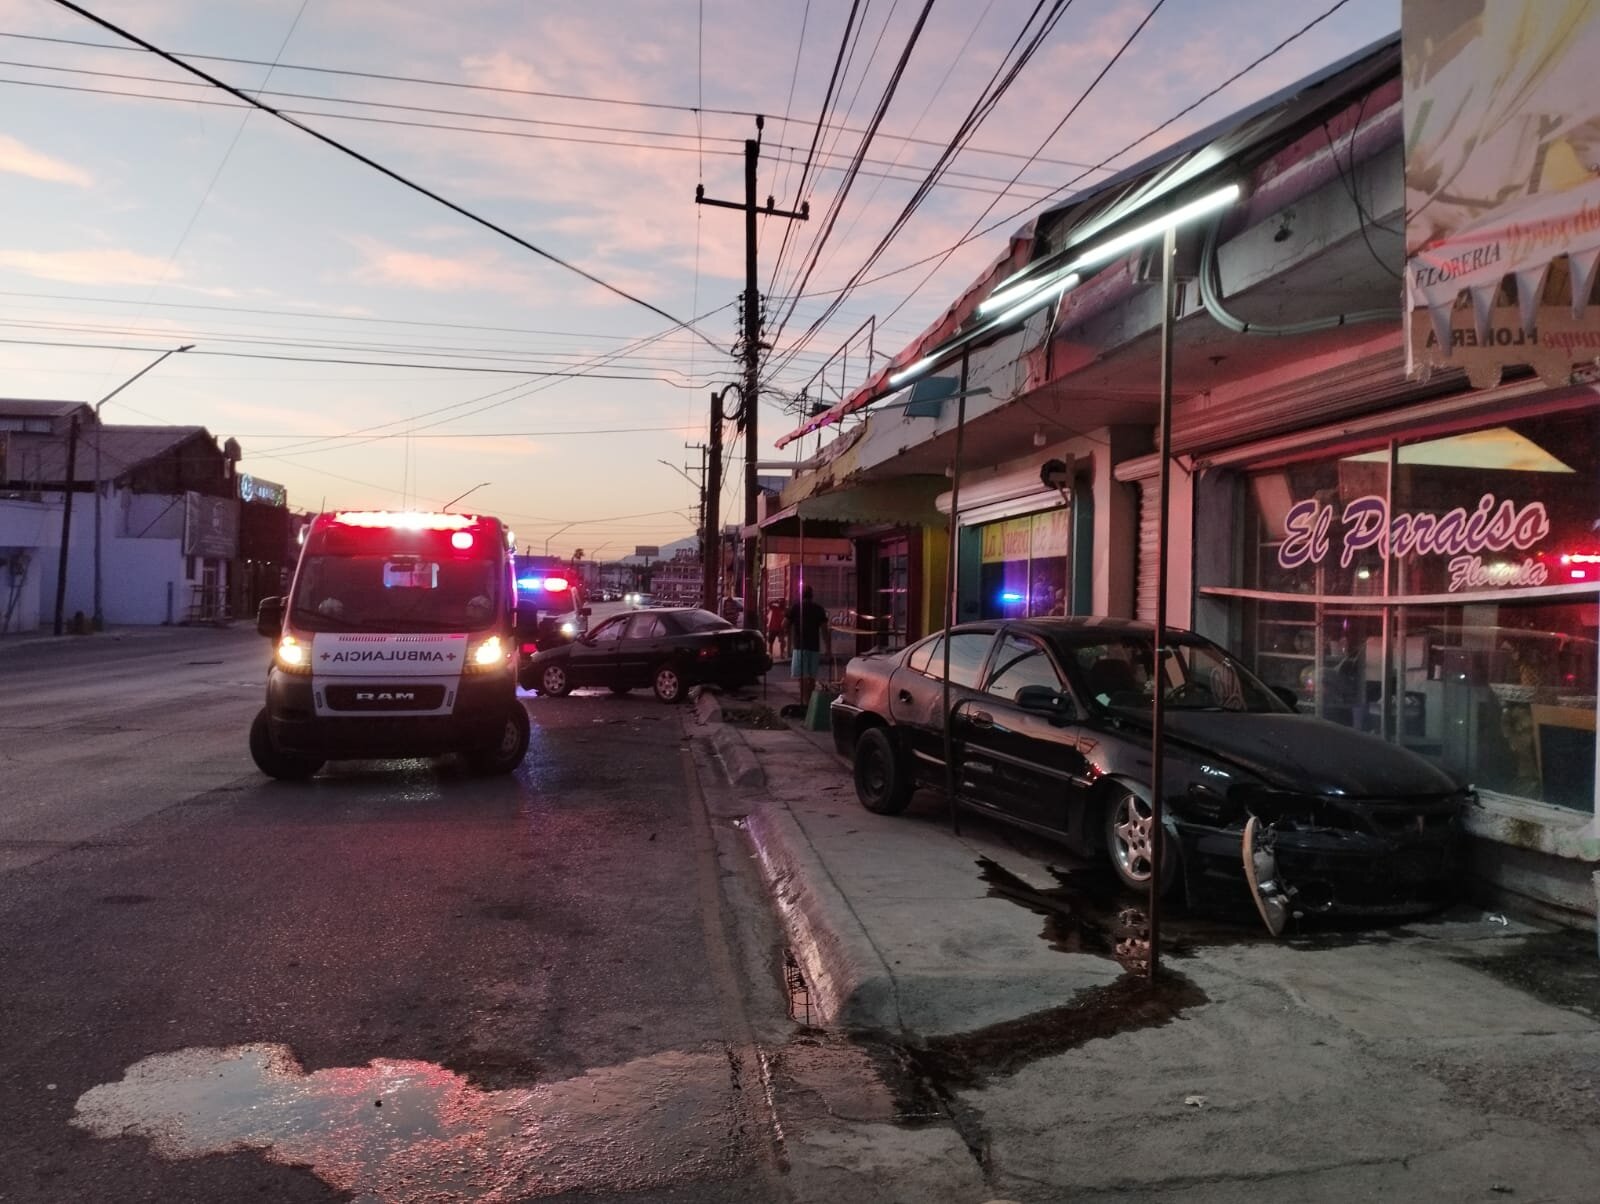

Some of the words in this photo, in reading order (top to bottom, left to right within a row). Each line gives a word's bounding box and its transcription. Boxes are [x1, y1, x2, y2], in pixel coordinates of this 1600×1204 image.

[1416, 242, 1500, 288] FLORERIA
[1279, 499, 1332, 568] El
[1341, 494, 1549, 568] Paraiso
[356, 692, 415, 701] RAM
